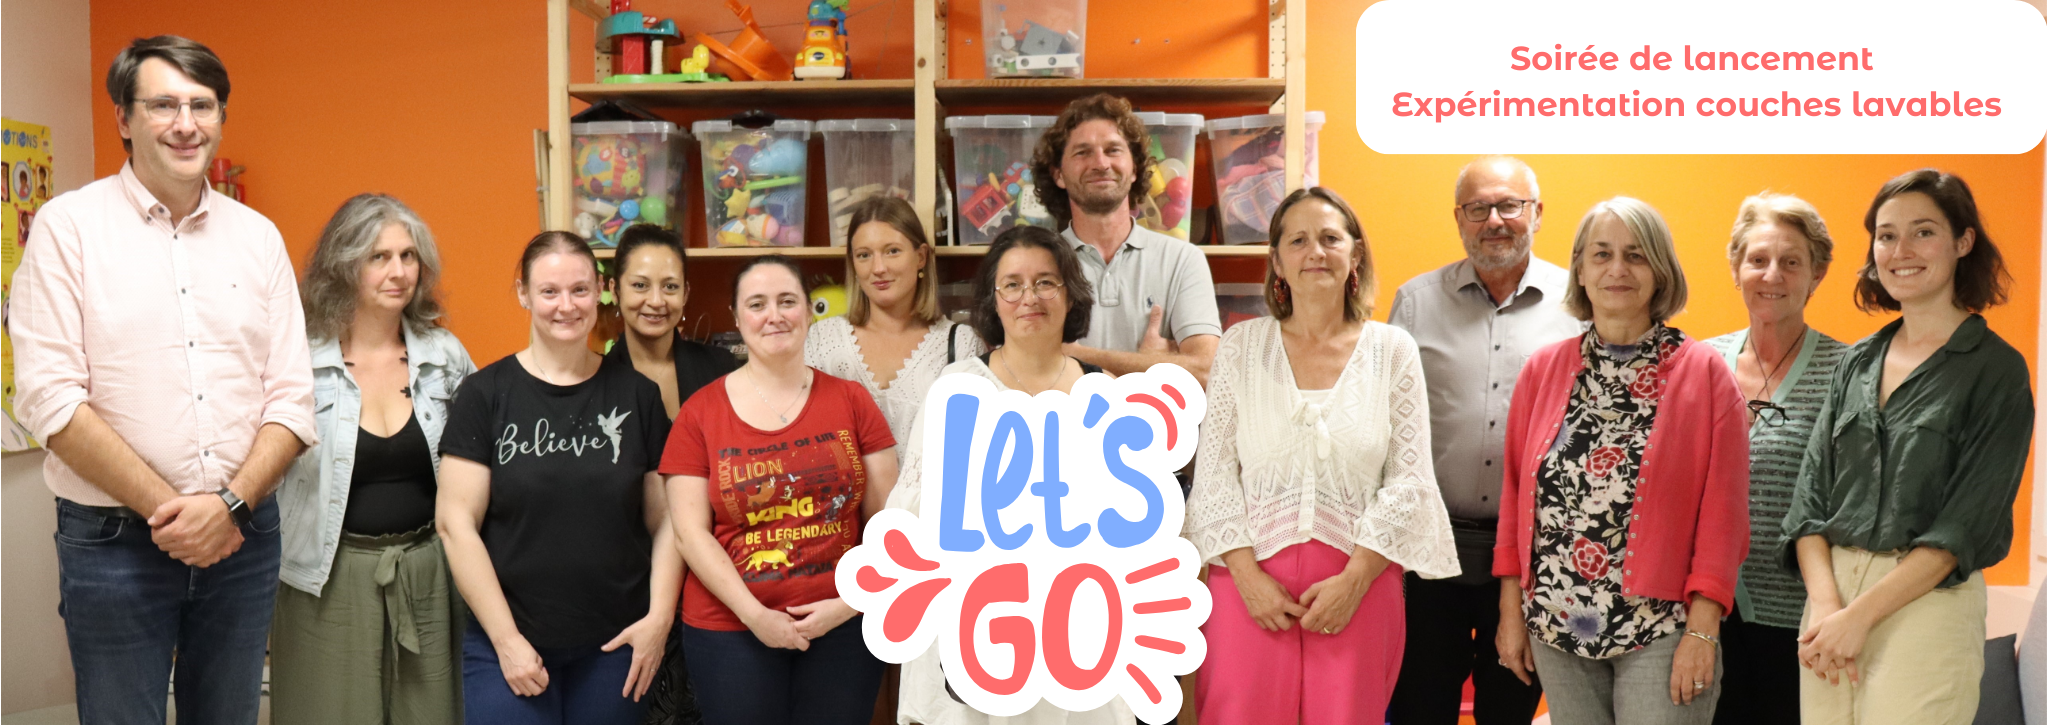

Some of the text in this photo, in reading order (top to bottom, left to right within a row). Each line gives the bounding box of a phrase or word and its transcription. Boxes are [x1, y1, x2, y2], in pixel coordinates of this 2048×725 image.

[1, 128, 38, 149] OTIONS
[495, 418, 608, 465] Believe
[794, 437, 811, 448] OF
[814, 431, 837, 444] LIFE
[837, 429, 865, 485] REMEMBER
[718, 456, 733, 491] ROCK
[733, 458, 784, 485] LION
[745, 531, 762, 545] BE
[766, 521, 842, 543] LEGENDARY
